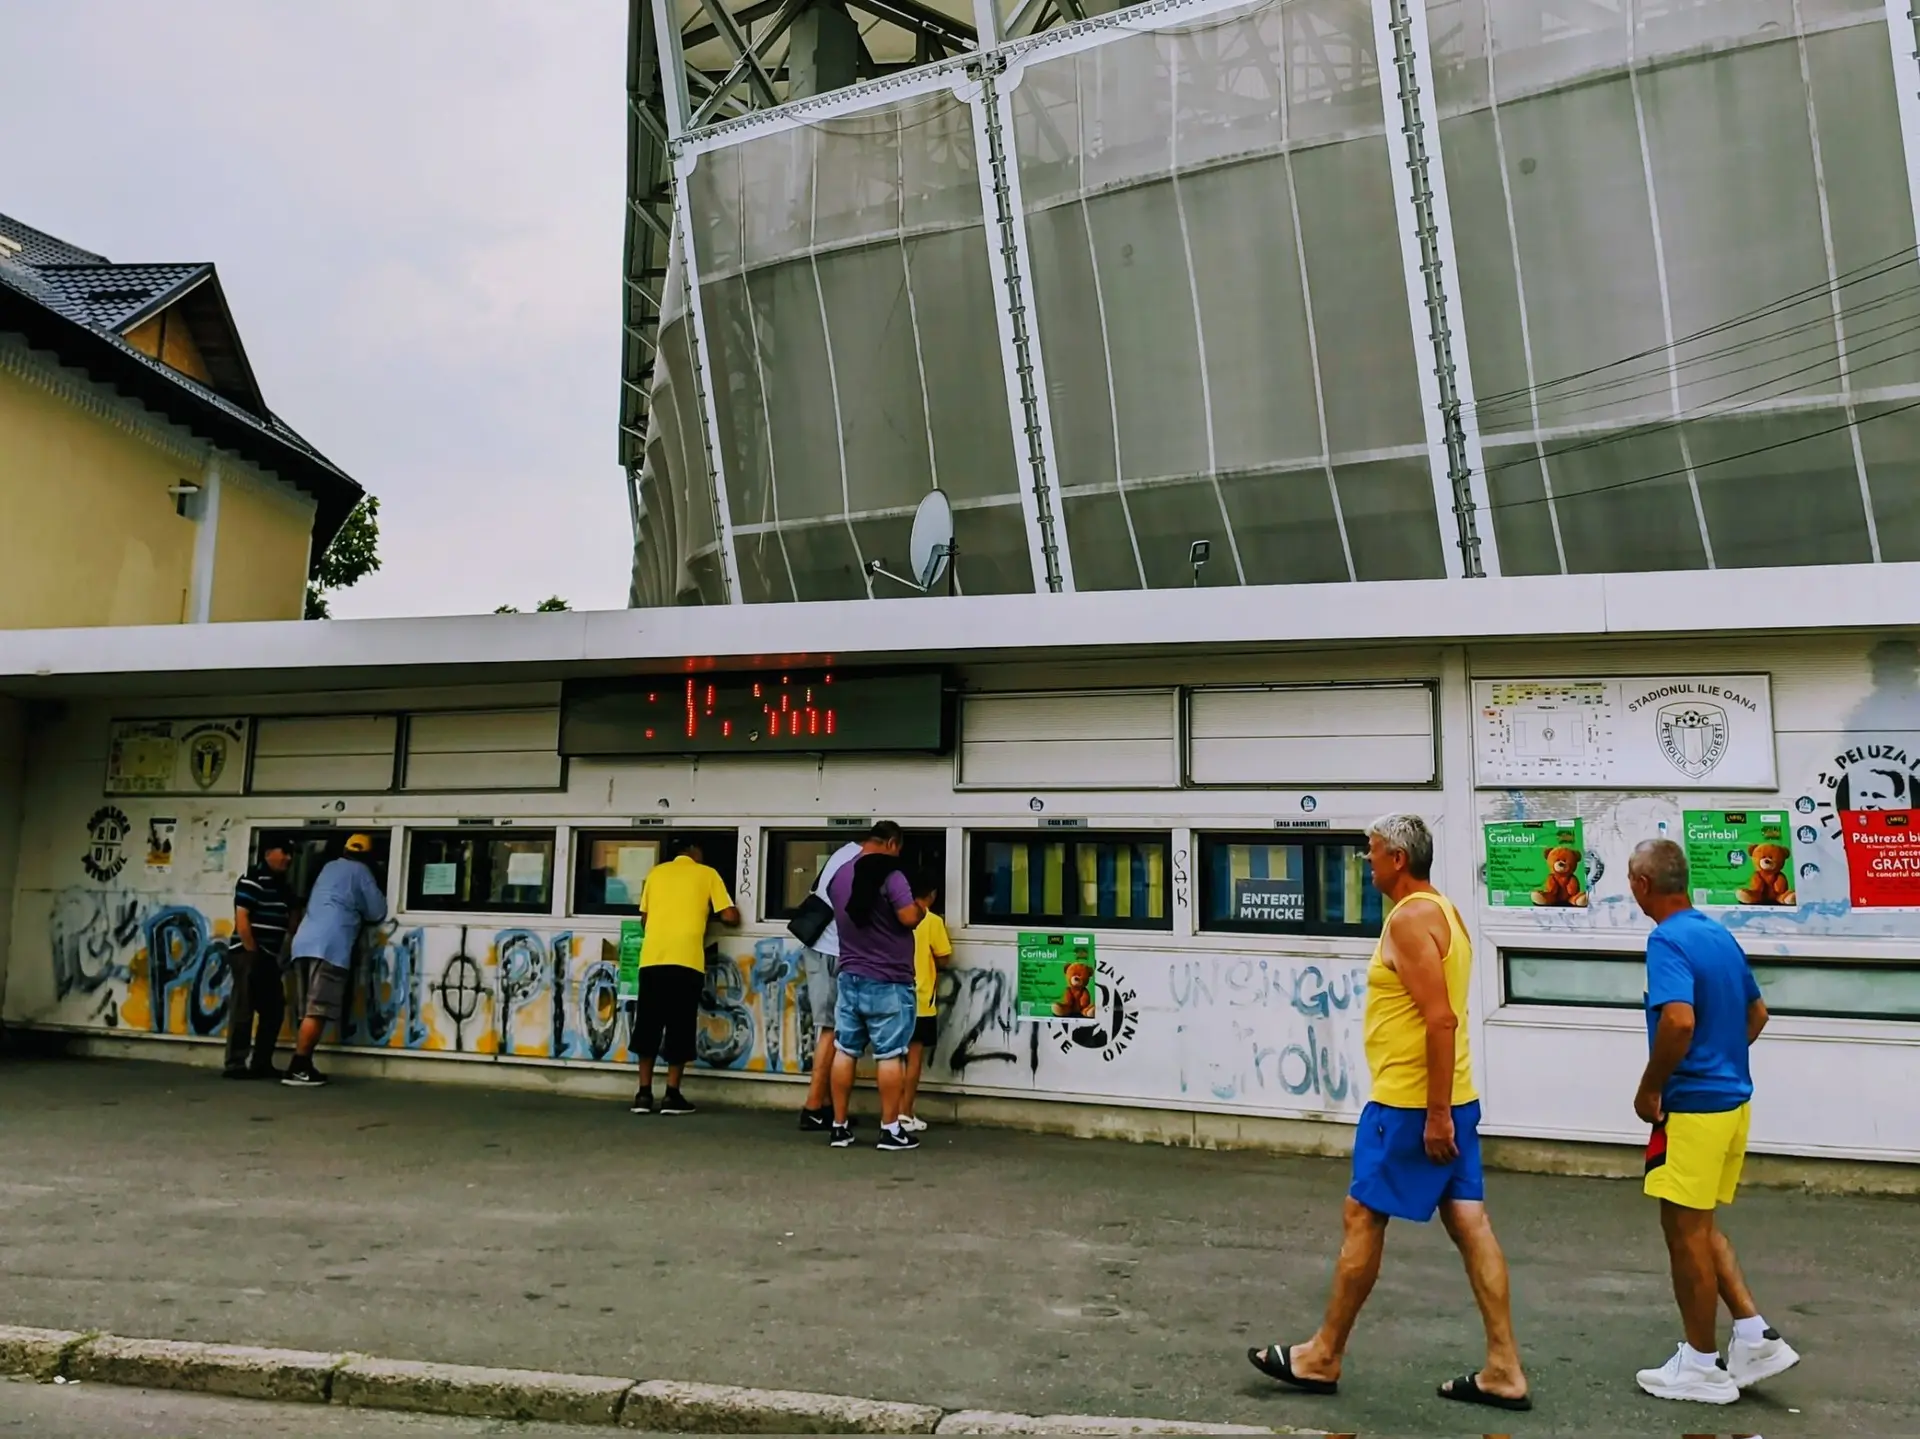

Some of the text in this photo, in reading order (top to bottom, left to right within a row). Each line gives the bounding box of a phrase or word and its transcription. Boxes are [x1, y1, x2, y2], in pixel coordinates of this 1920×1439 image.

[1628, 684, 1694, 712] STADIONUL
[1697, 684, 1720, 697] ILIE
[1723, 690, 1757, 712] OANA
[1675, 716, 1710, 727] F C
[1662, 722, 1687, 768] PETROLUL
[1835, 744, 1907, 770] PELUZA
[1818, 772, 1838, 789] 19
[1817, 802, 1844, 840] ILI
[1488, 832, 1536, 844] Caritabil
[1687, 828, 1739, 840] Caritabil
[1852, 832, 1905, 843] Păstreză
[1872, 858, 1920, 870] GRATU
[1240, 907, 1304, 920] MYTICKE
[1021, 948, 1058, 959] Caritabil
